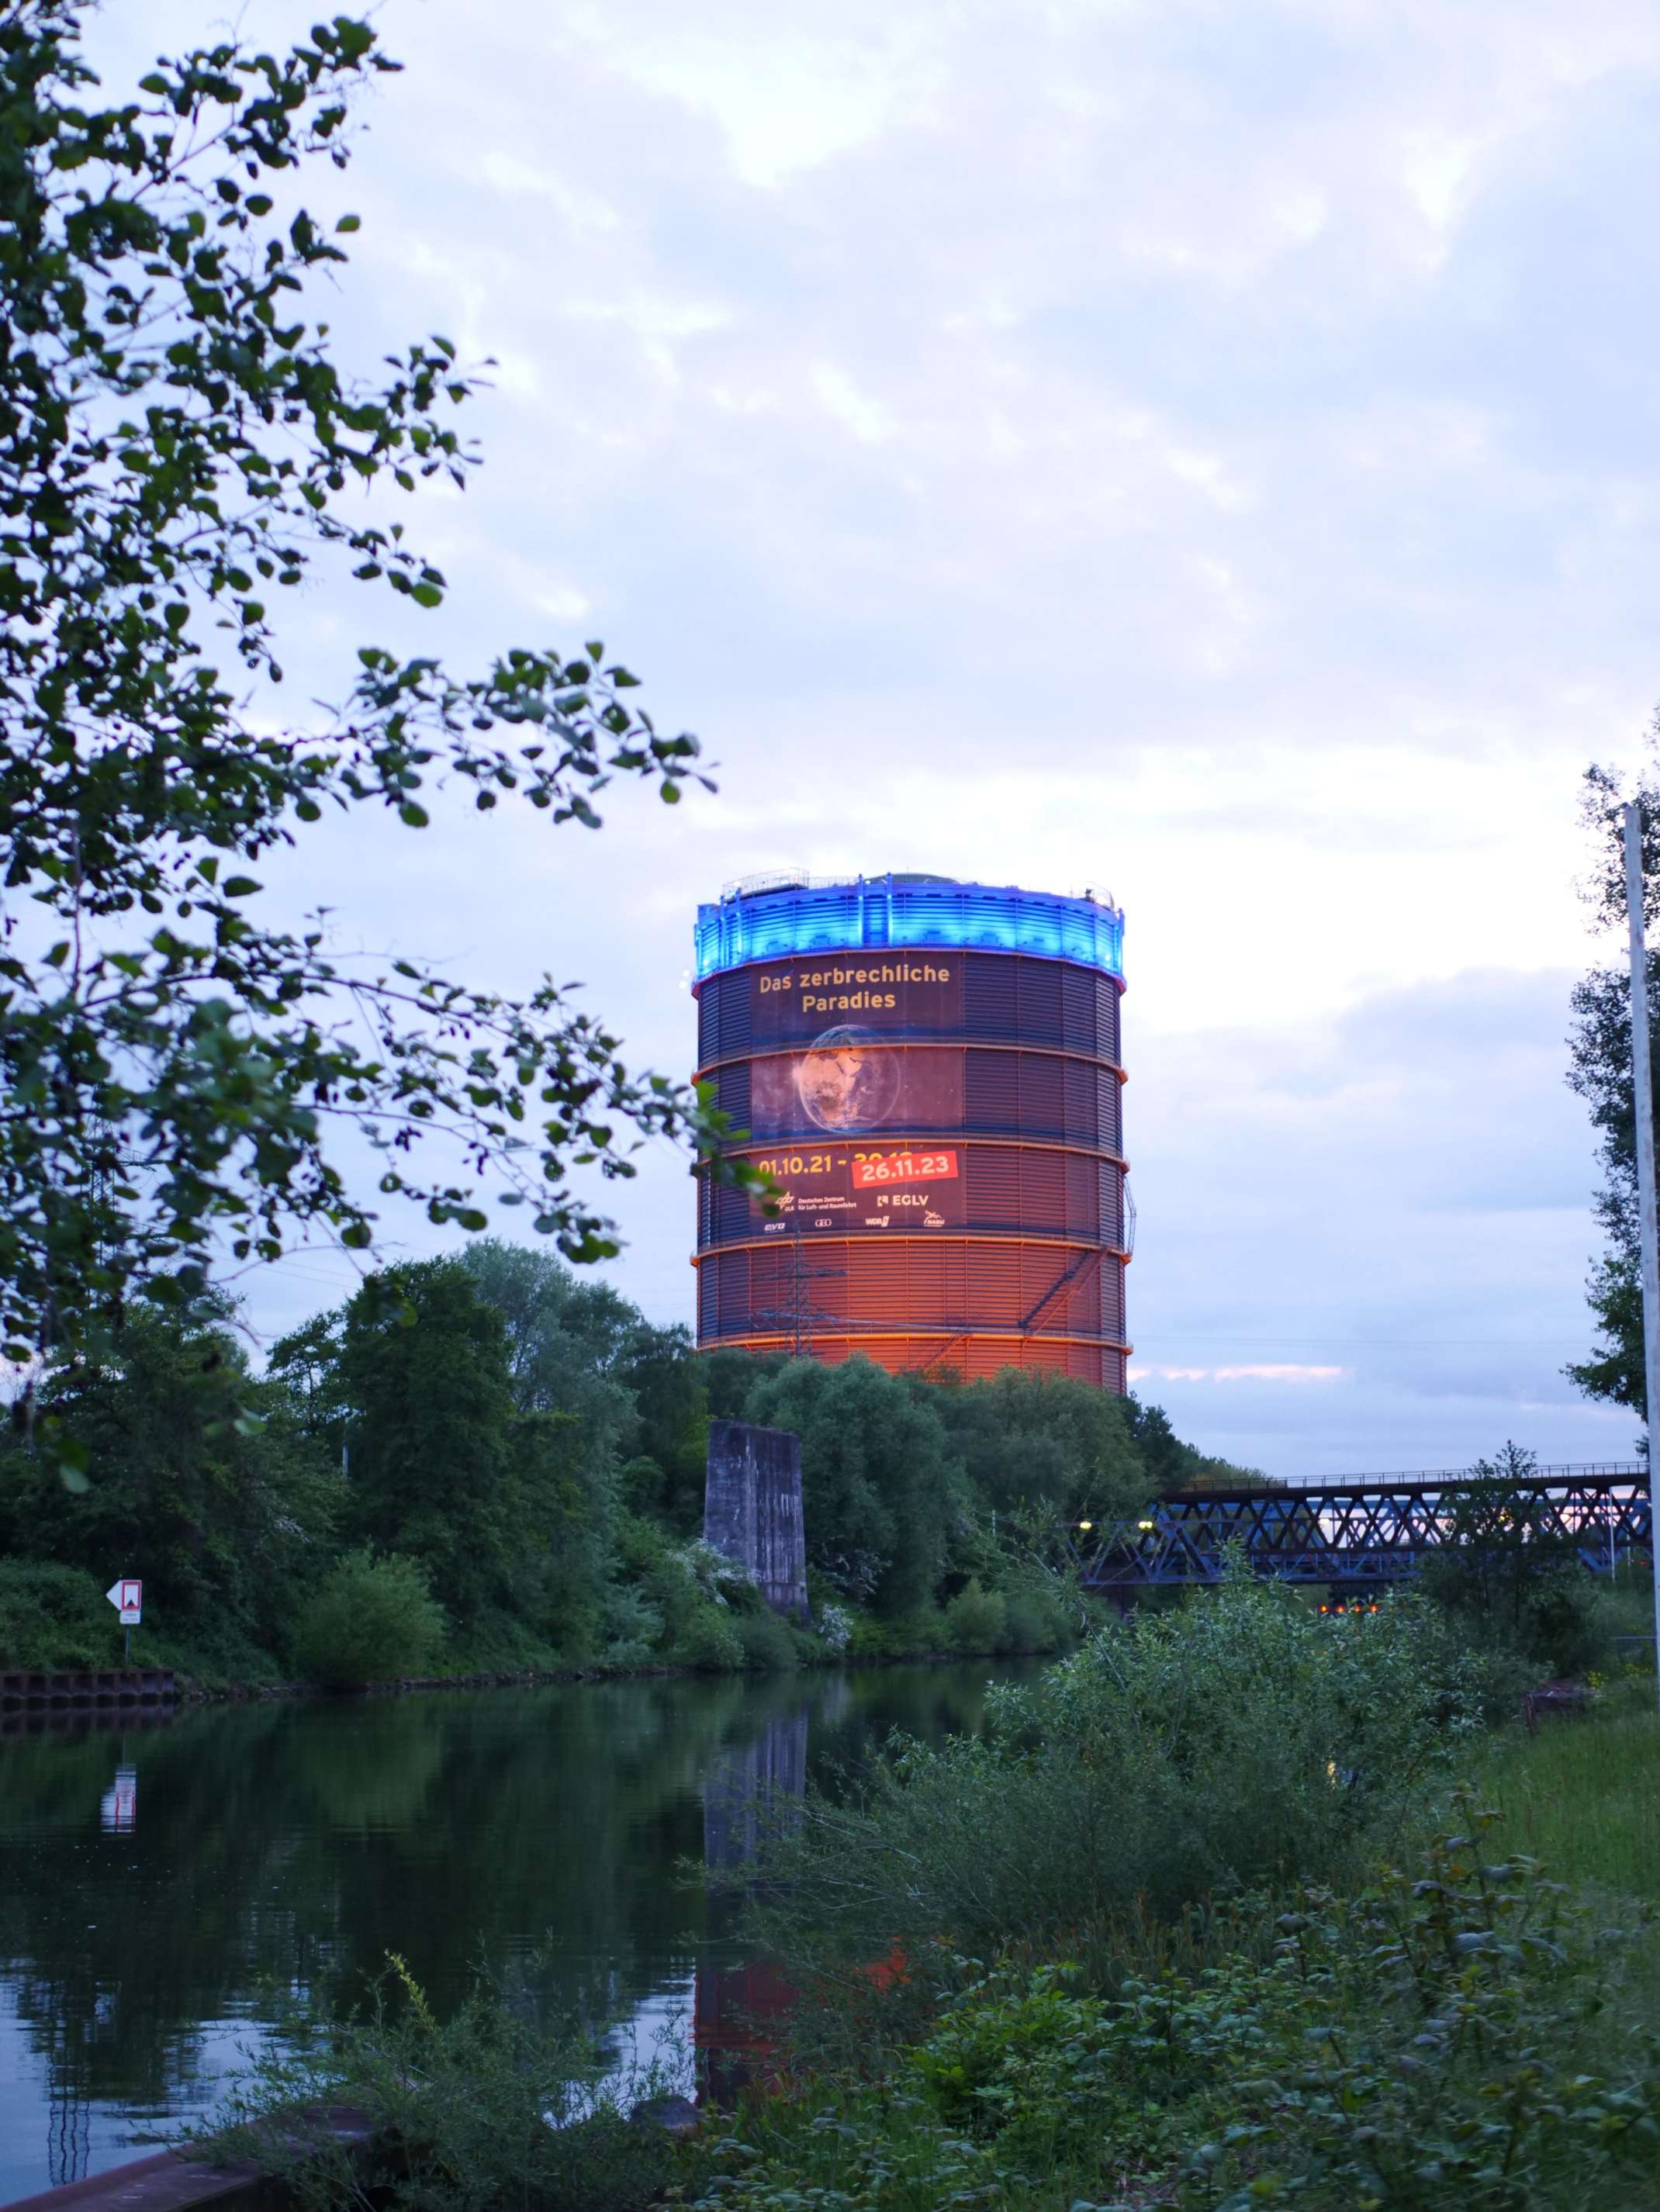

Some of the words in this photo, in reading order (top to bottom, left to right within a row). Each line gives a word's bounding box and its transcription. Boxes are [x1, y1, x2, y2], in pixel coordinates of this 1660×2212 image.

[759, 974, 792, 994] Das
[800, 964, 950, 988] zerbrechliche
[802, 990, 896, 1012] Paradies
[759, 1155, 831, 1175] 01.10.21
[861, 1156, 949, 1181] 26.11.23
[892, 1194, 929, 1206] EGLV
